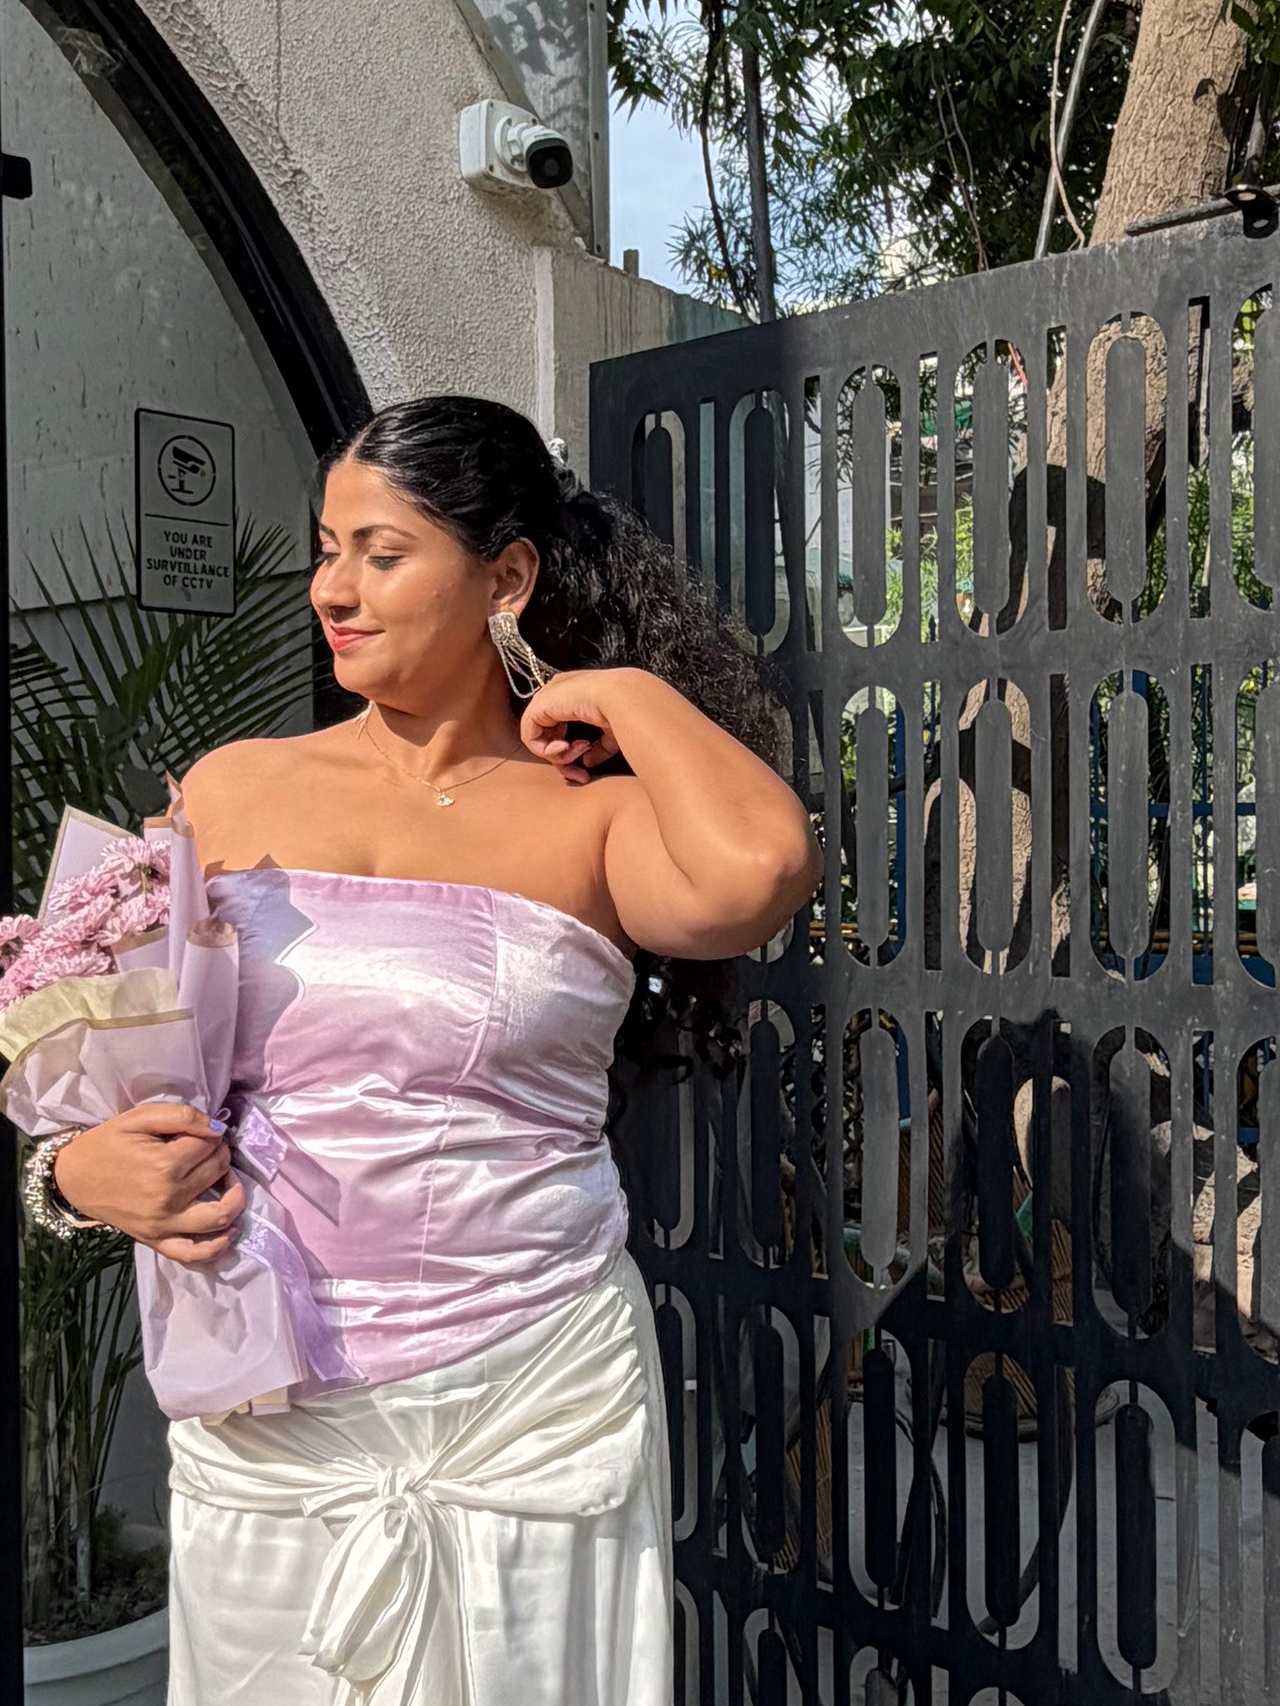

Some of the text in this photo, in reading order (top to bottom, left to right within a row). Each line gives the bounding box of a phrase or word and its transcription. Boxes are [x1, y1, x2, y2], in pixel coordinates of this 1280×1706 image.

[163, 530, 213, 548] YOU ARE
[170, 545, 207, 561] UNDER
[146, 558, 230, 578] SURVEILLANCE
[163, 574, 214, 589] OF CCTV
